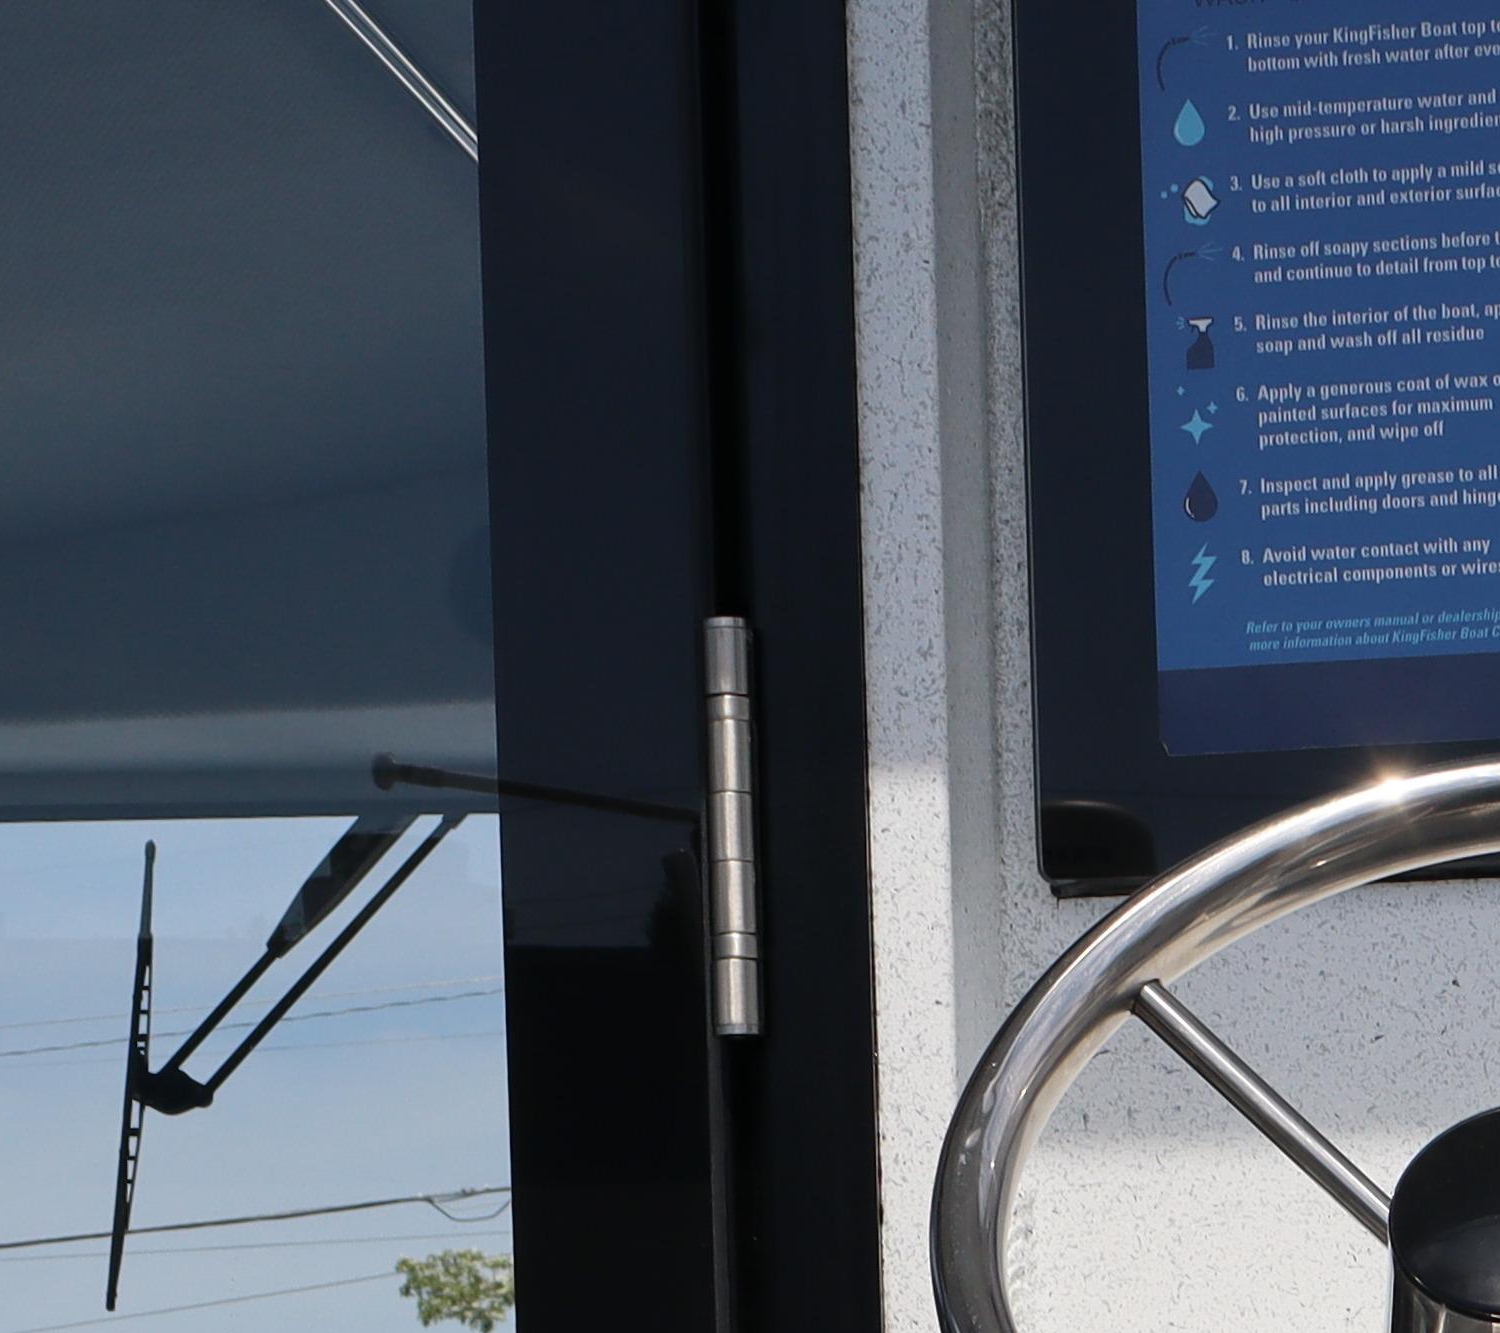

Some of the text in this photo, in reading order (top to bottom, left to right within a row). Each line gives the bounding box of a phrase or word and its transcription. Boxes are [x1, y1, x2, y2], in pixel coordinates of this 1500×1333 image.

[1247, 55, 1300, 72] bottom
[1303, 49, 1338, 68] with
[1341, 47, 1381, 66] fresh
[1384, 46, 1430, 63] water
[1433, 42, 1469, 60] after
[1249, 124, 1283, 145] high
[1287, 123, 1356, 144] pressure
[1359, 122, 1376, 135] or
[1380, 115, 1424, 134] harsh
[1251, 198, 1266, 213] to
[1270, 194, 1290, 212] all
[1294, 191, 1352, 210] interior
[1356, 188, 1385, 206] and
[1389, 185, 1452, 204] exterior
[1252, 243, 1296, 260] Rinse
[1299, 240, 1319, 257] off
[1323, 240, 1369, 257] soapy
[1372, 234, 1437, 252] sections
[1440, 230, 1490, 249] before
[1253, 265, 1282, 283] and
[1285, 262, 1352, 281] continue
[1355, 262, 1371, 277] to
[1374, 256, 1419, 275] detail
[1422, 256, 1458, 273] from
[1460, 255, 1486, 273] top
[1255, 324, 1484, 356] soap and wash off all residue
[1257, 395, 1493, 428] painted surfaces for maximum
[1258, 419, 1444, 451] protection, and wipe off
[1260, 500, 1300, 521] parts
[1304, 494, 1377, 514] including
[1381, 492, 1425, 509] doors
[1429, 488, 1458, 507] and
[1262, 545, 1306, 564] Avoid
[1309, 545, 1355, 561] water
[1360, 540, 1419, 558] contact
[1422, 536, 1458, 554] with
[1462, 538, 1490, 555] any
[1262, 566, 1338, 586] electrical
[1342, 562, 1437, 584] components
[1440, 563, 1457, 576] or
[1248, 639, 1280, 651] more
[1282, 632, 1352, 649] information
[1354, 630, 1390, 645] about
[1390, 627, 1457, 645] KingFisher
[1459, 625, 1489, 640] Boat
